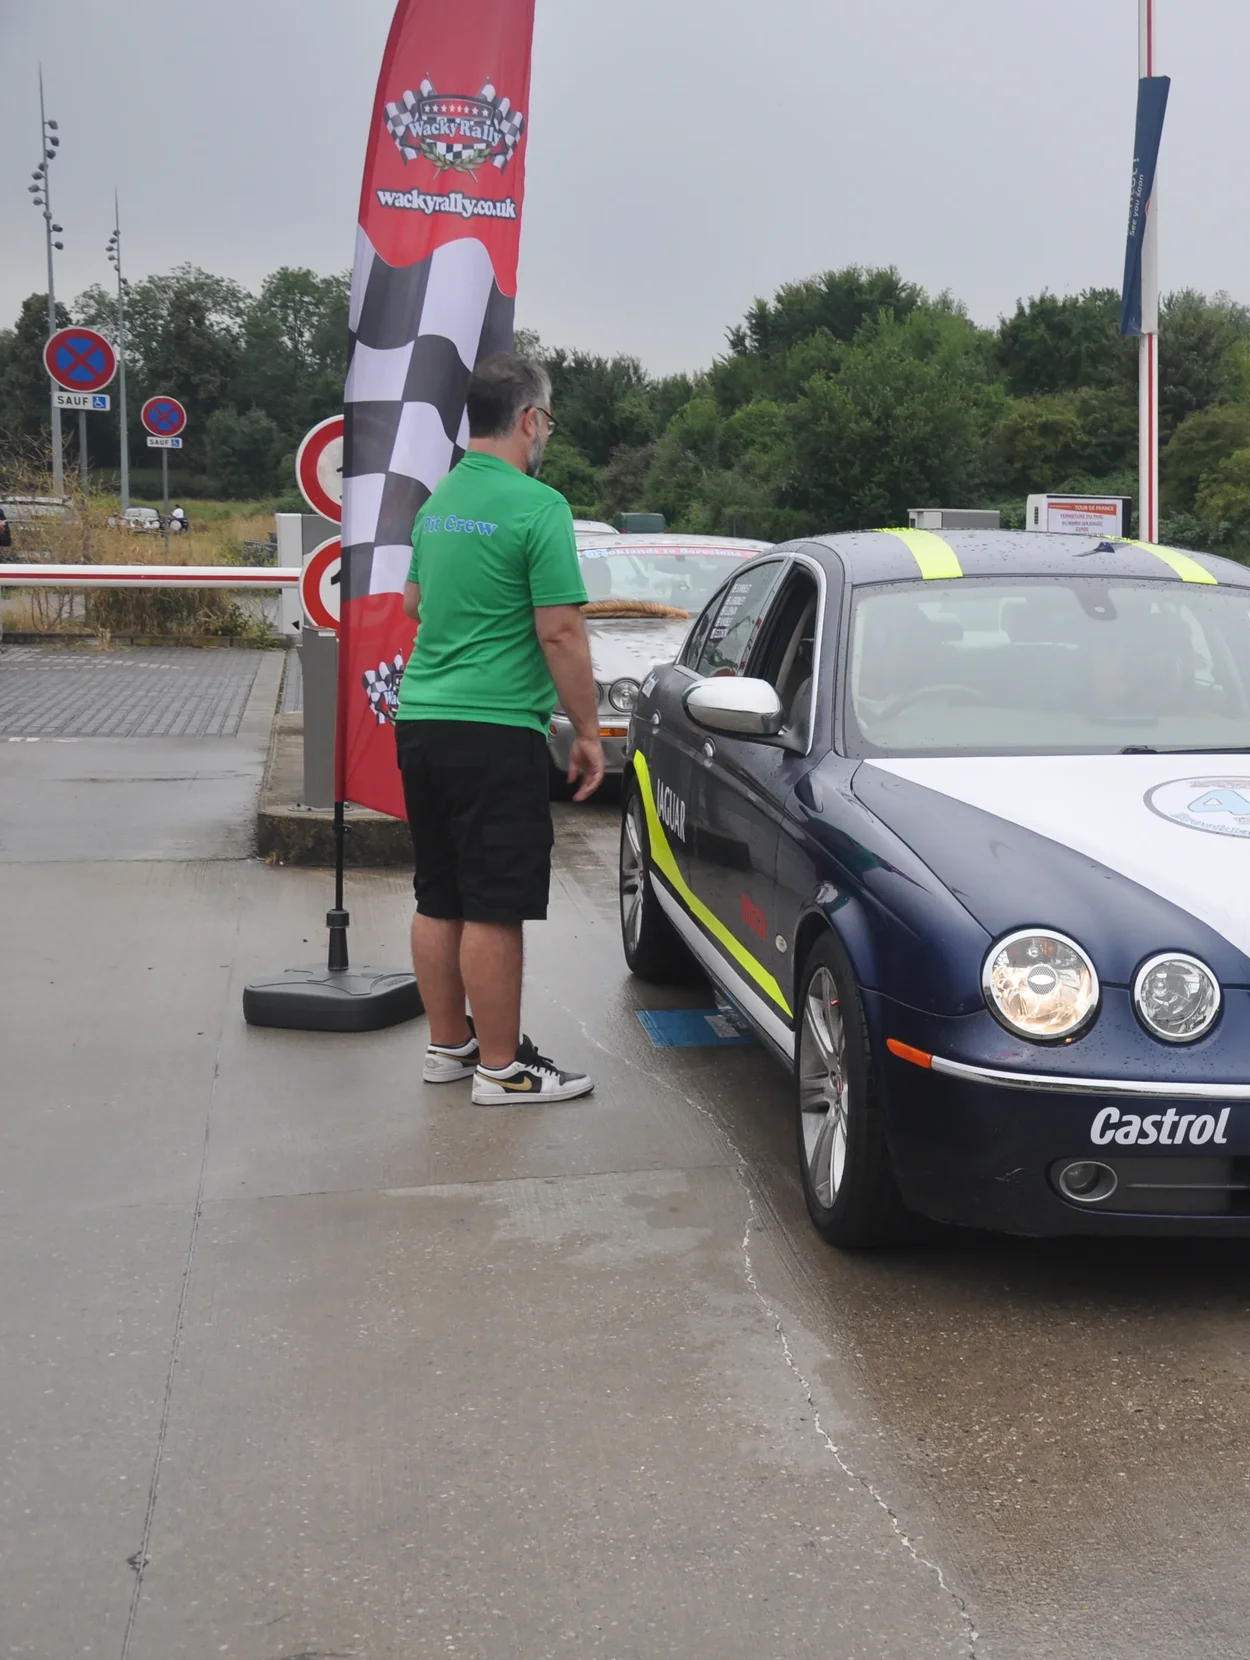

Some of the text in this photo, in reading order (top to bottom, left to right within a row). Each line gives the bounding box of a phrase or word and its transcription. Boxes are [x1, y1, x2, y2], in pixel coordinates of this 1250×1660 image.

[408, 117, 502, 147] Wacky Rally
[376, 188, 517, 218] wackyrally.co.uk
[57, 395, 89, 406] SAUF
[423, 514, 498, 536] Pit Crew
[657, 778, 686, 843] JAGUAR
[1089, 1106, 1230, 1146] Castrol
